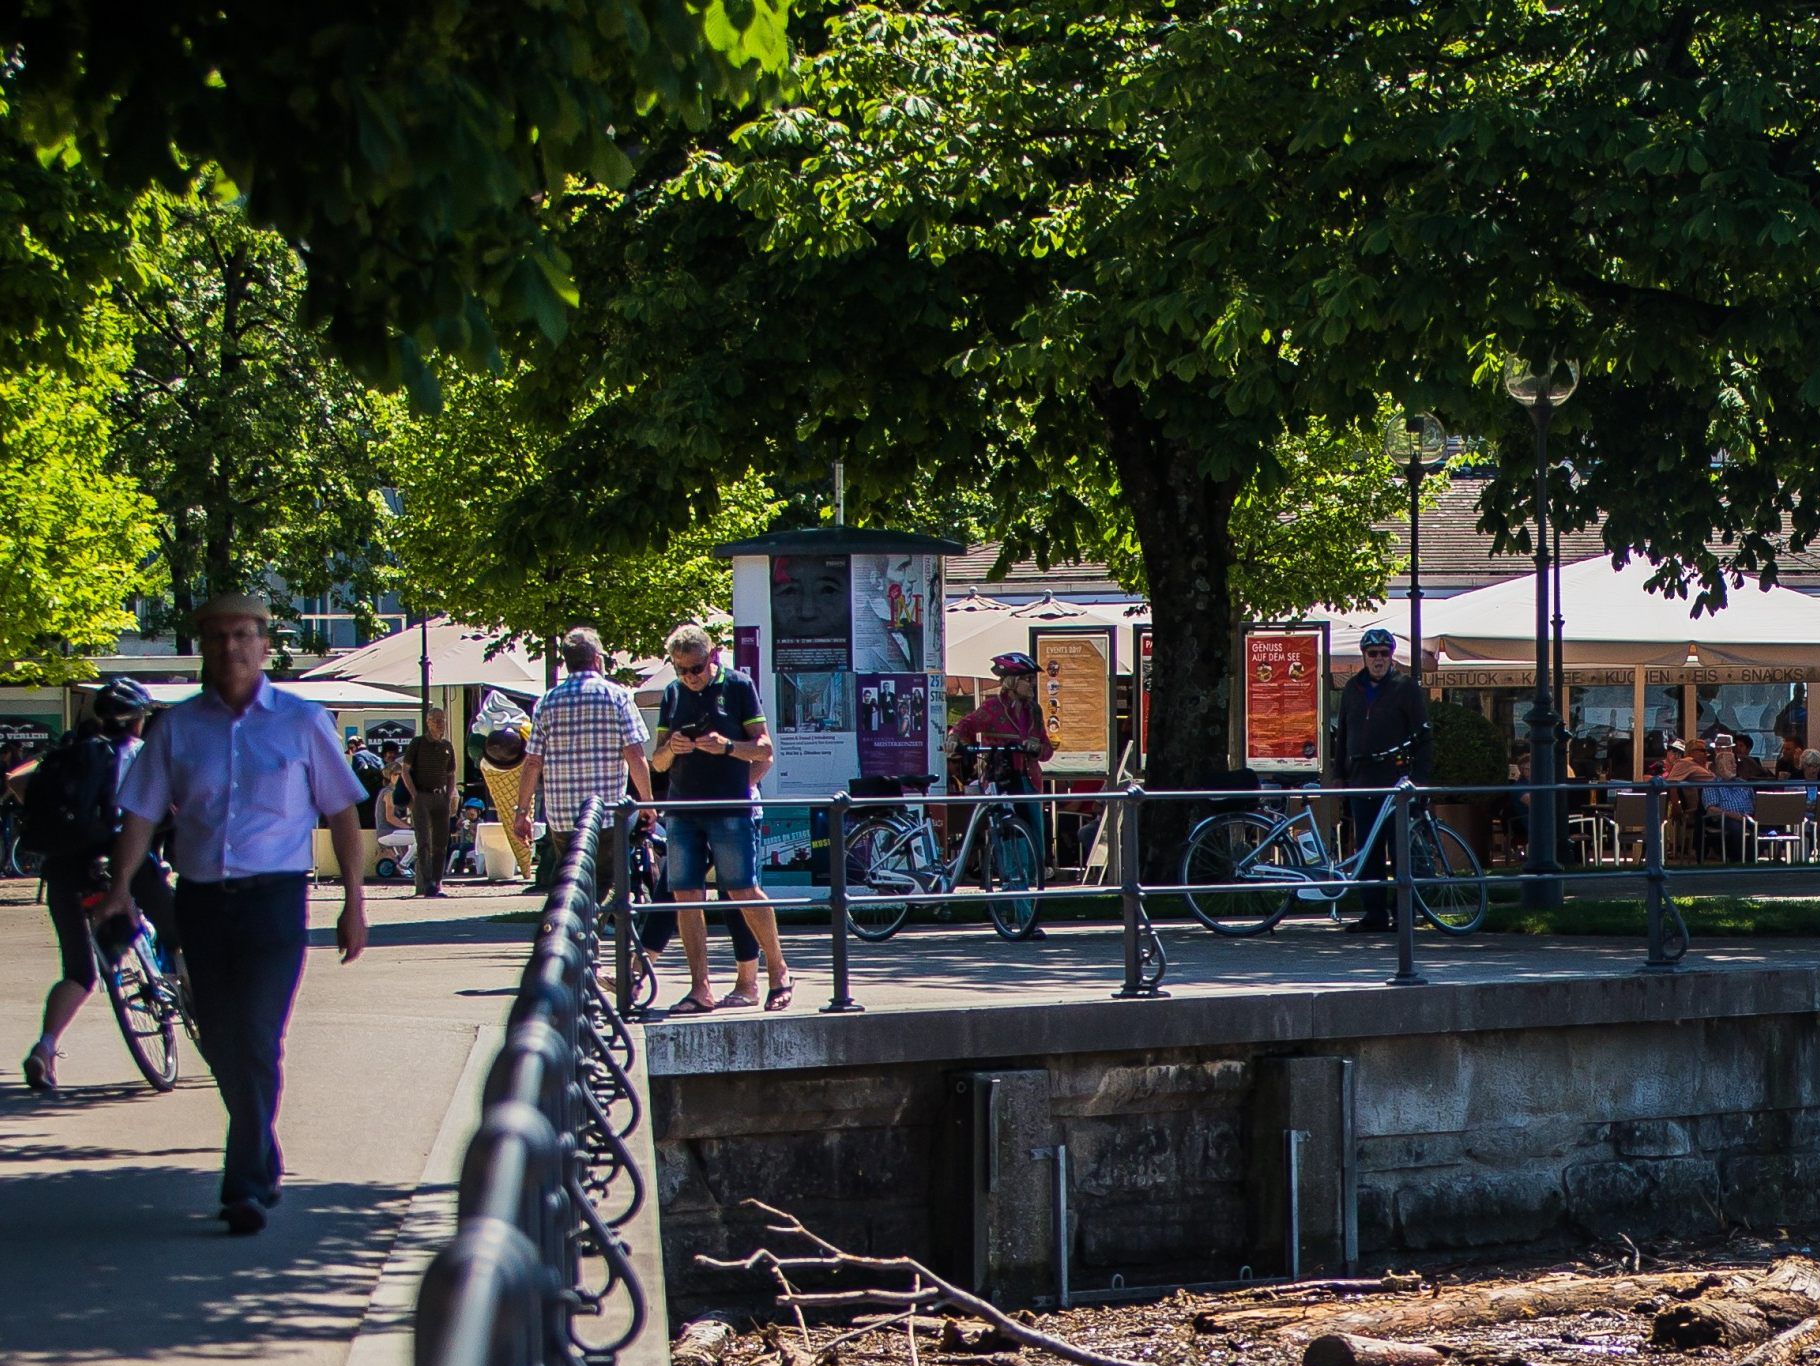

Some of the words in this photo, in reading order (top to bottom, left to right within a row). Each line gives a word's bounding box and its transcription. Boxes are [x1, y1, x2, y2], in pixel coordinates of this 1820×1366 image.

[1251, 642, 1283, 652] GENUSS
[1251, 653, 1267, 662] AUF
[1268, 653, 1286, 662] DEM
[1287, 652, 1301, 661] SEE
[1605, 670, 1670, 684] KUCEN
[1693, 669, 1718, 683] EIS
[1741, 668, 1804, 682] SNACKS
